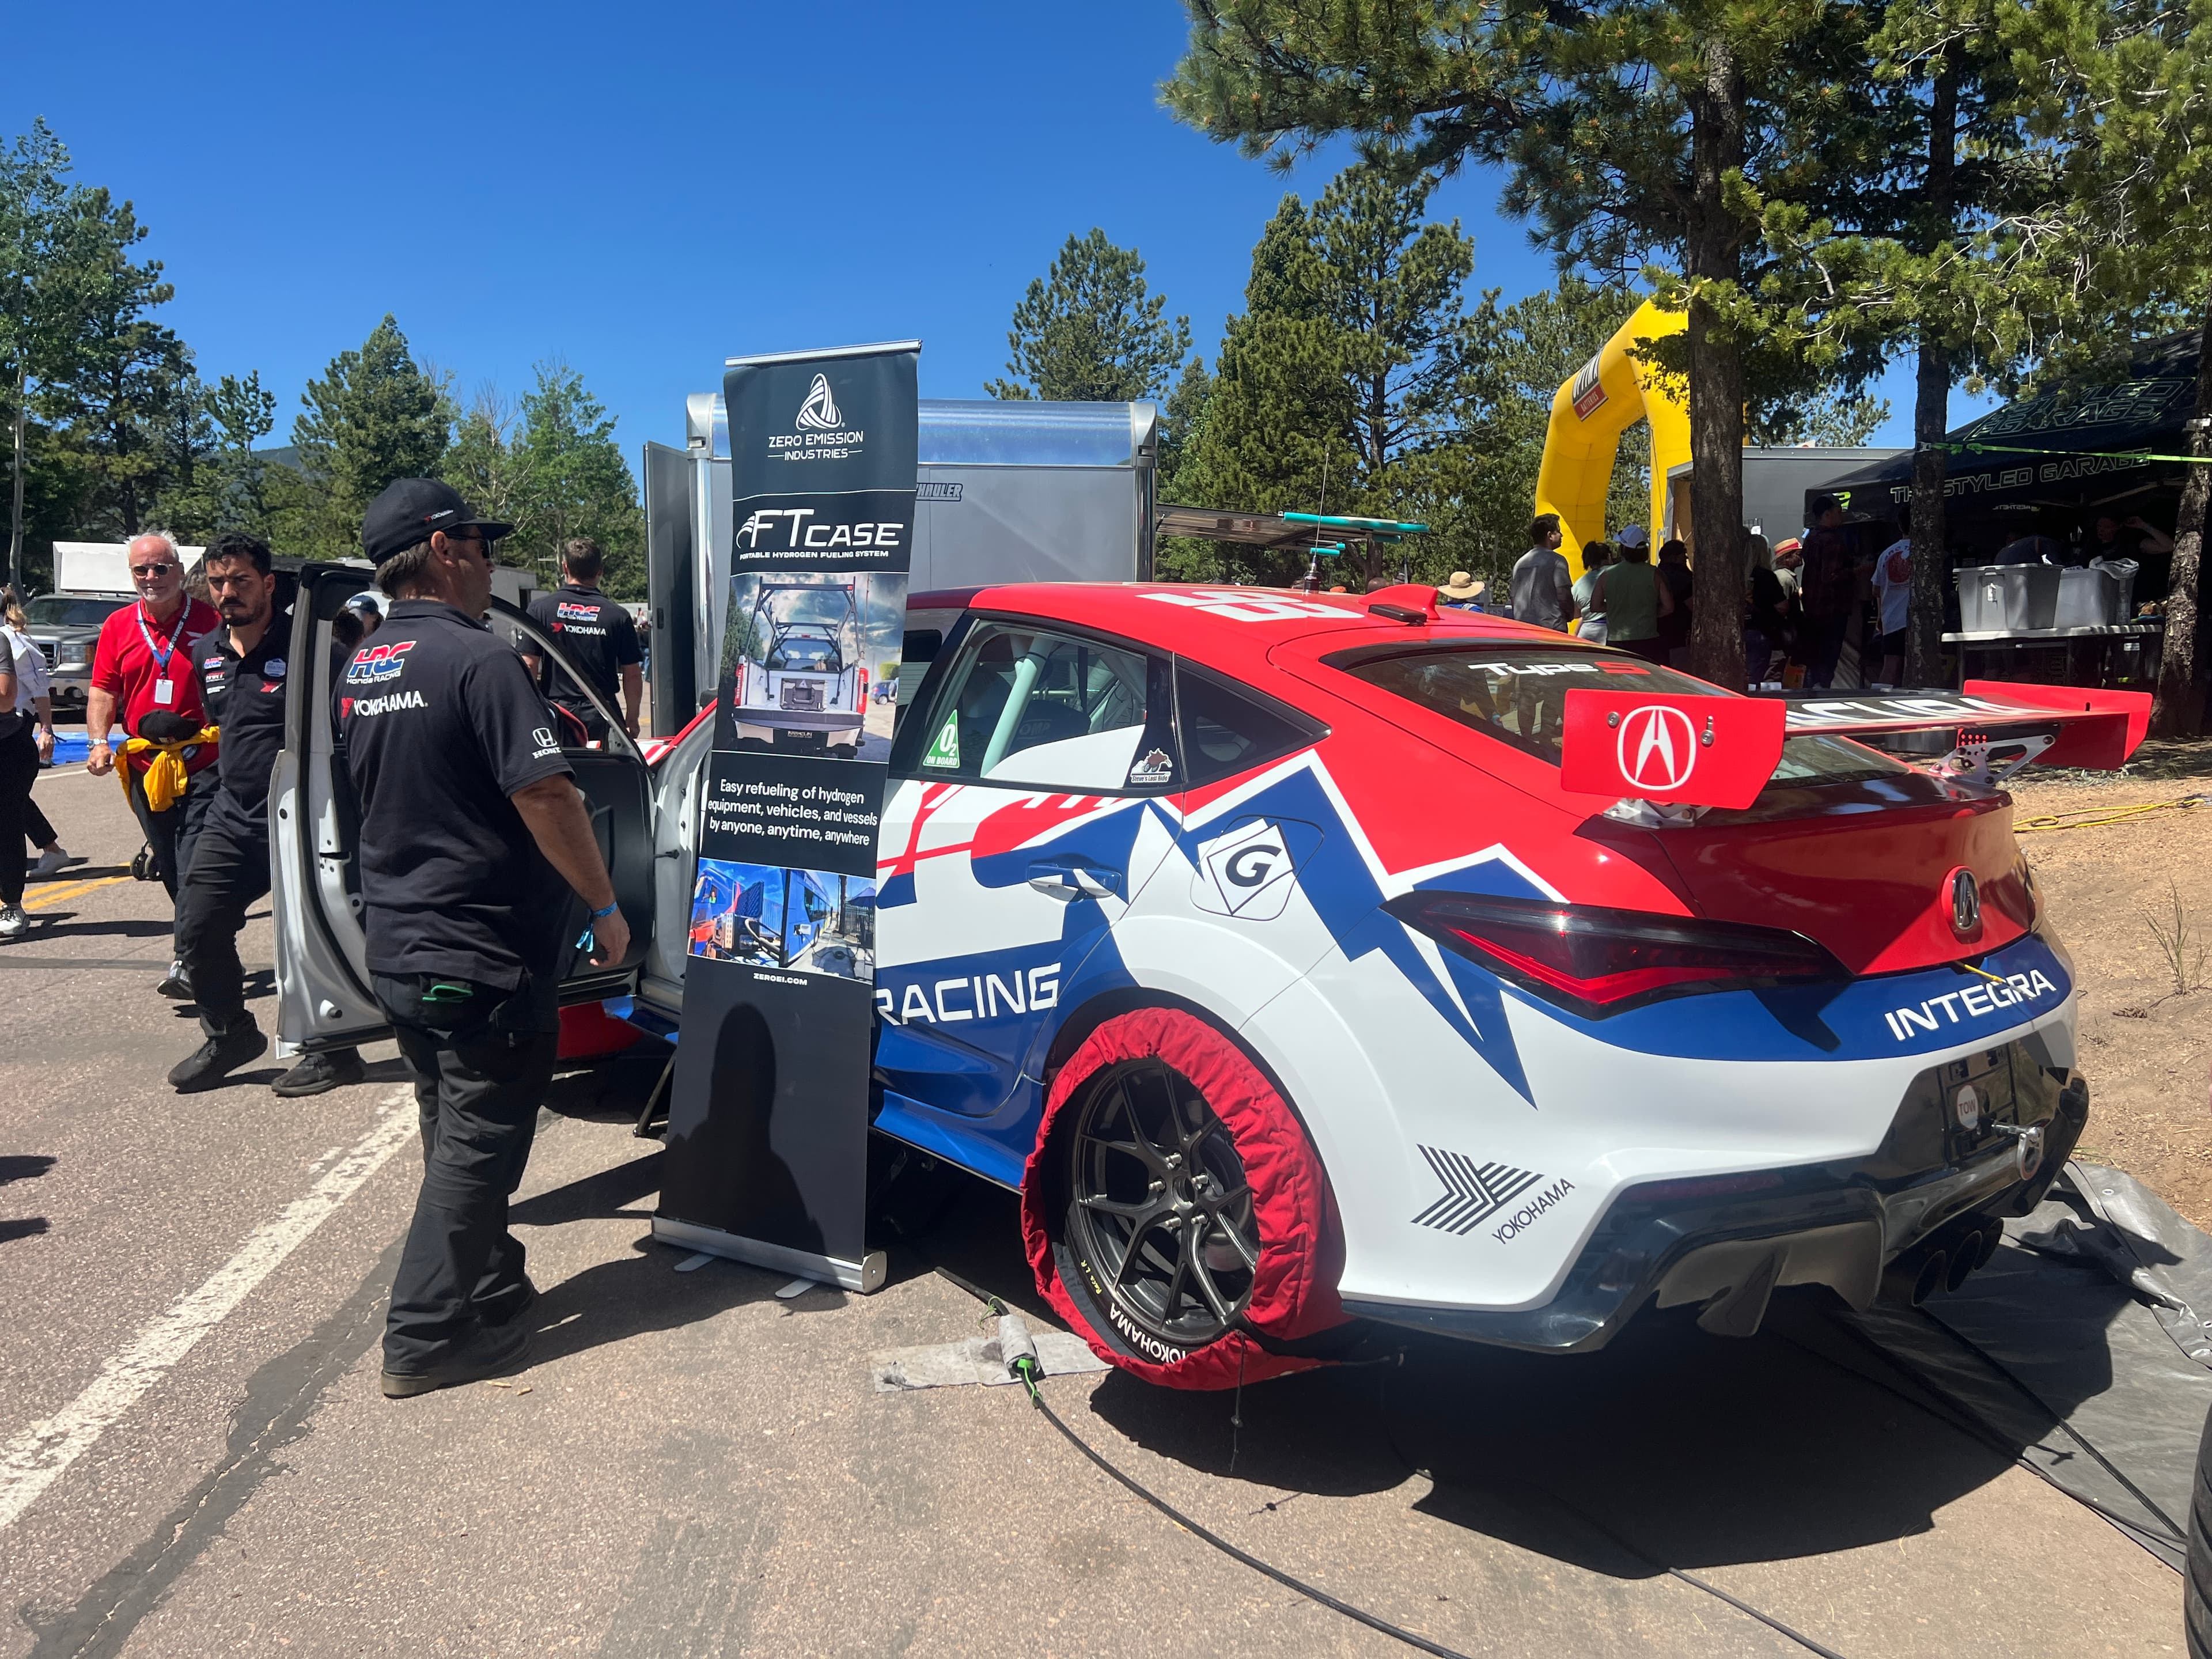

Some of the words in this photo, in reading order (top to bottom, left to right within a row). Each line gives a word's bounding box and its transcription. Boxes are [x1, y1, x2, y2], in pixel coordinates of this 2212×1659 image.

[768, 435, 802, 448] ZERO
[805, 430, 863, 445] EMISSION
[784, 448, 849, 461] INDUSTRIES
[1890, 486, 1912, 504] TH
[740, 551, 770, 560] PORTABLE
[564, 624, 607, 636] YOKOHAMA
[347, 641, 417, 678] HRC
[1468, 662, 1599, 676] Type
[1594, 661, 1651, 675] S
[926, 755, 936, 764] ON
[936, 756, 957, 766] BOARD
[720, 779, 744, 796] Easy
[745, 782, 799, 801] refueling
[802, 786, 817, 800] of
[819, 786, 864, 806] hydrogen
[708, 798, 764, 816] equipment,
[767, 803, 821, 822] vehicles,
[823, 808, 842, 822] and
[843, 812, 878, 826] vessels
[709, 816, 720, 833] by
[721, 820, 765, 836] anyone,
[767, 824, 823, 842] anytime,
[824, 830, 870, 846] anywhere
[1225, 844, 1282, 887] G
[753, 972, 808, 986] ZEROEI.COM
[872, 962, 1061, 1026] RACING
[1884, 969, 2057, 1041] INTEGRA
[1959, 1098, 1976, 1116] TOW
[1491, 1178, 1576, 1245] YOKOHAMA
